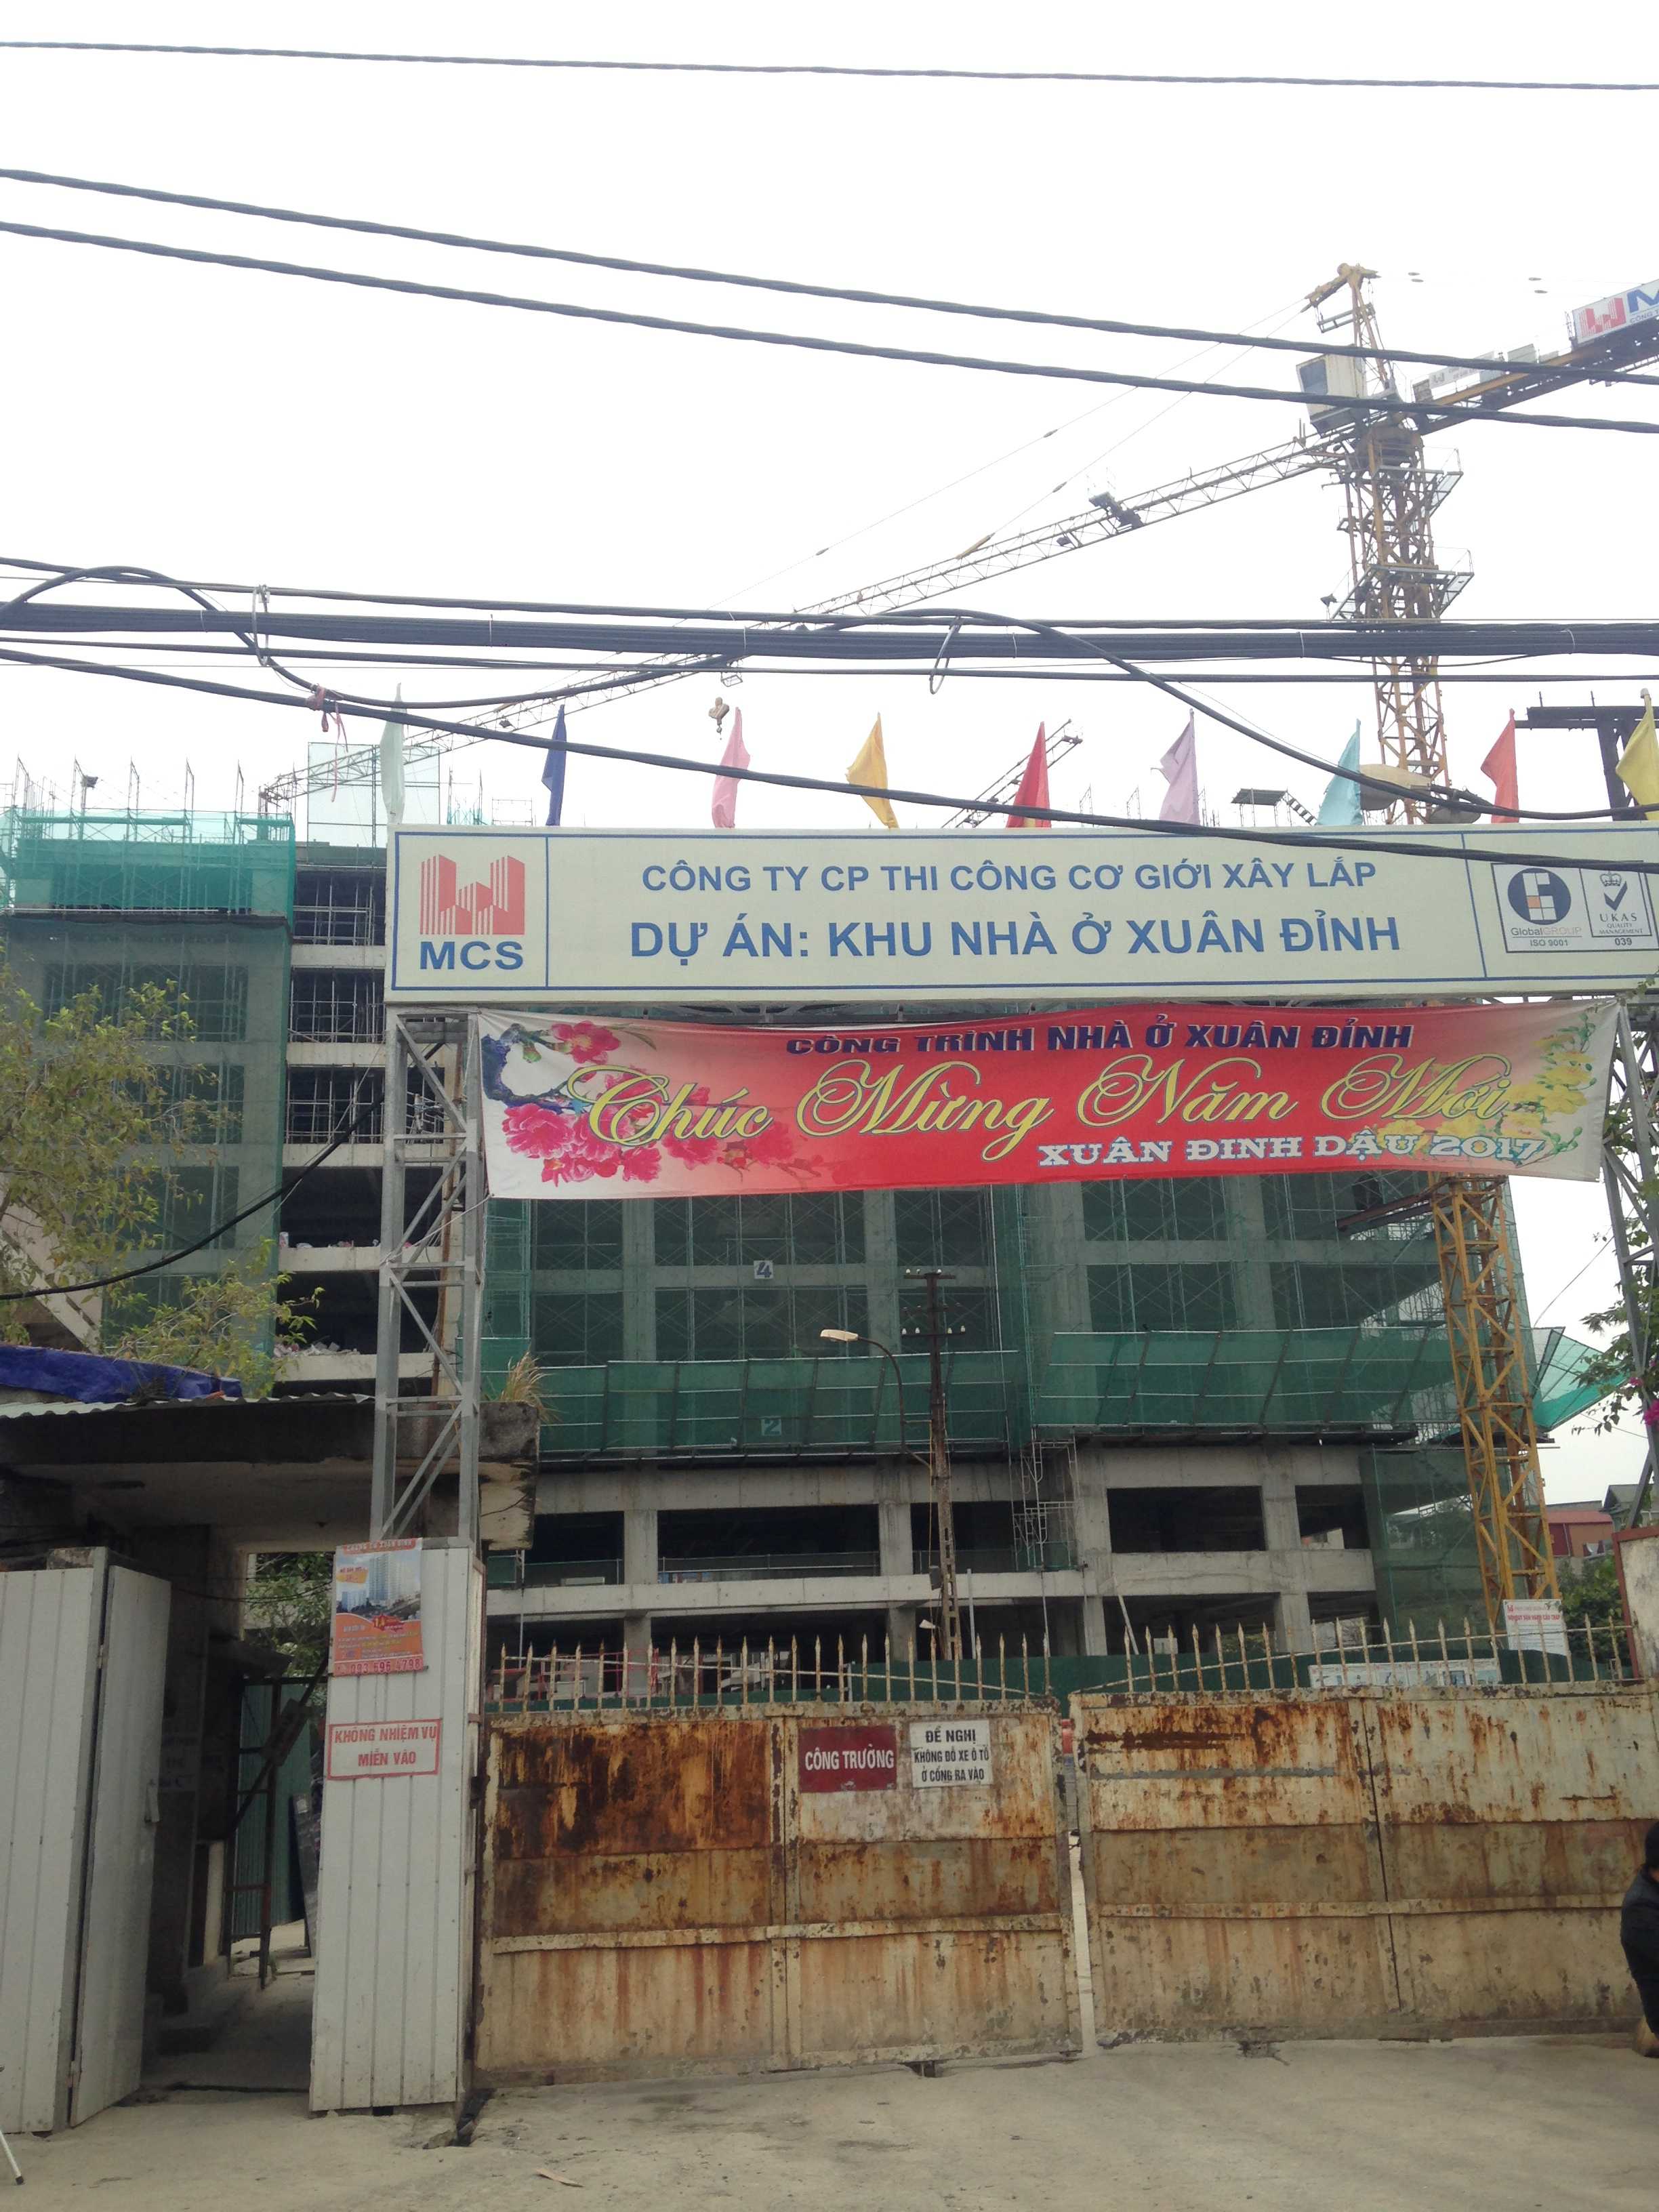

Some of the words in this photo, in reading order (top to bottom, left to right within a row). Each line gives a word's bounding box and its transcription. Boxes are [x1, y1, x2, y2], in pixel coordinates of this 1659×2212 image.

[642, 860, 751, 892] CÔNG
[763, 865, 808, 891] TY
[821, 865, 869, 892] CP
[880, 865, 938, 891] THI
[950, 859, 1056, 891] CÔNG
[1068, 864, 1123, 890] CƠ
[1135, 858, 1210, 890] GIỚI
[1223, 857, 1294, 889] XÂY
[1307, 855, 1376, 888] LẮP
[1599, 912, 1637, 922] UKAS
[632, 922, 708, 966] DỰ
[722, 913, 808, 958] ÁN:
[830, 921, 932, 957] KHU
[951, 912, 1057, 956] NHÀ
[1072, 912, 1111, 956] Ở
[1126, 909, 1265, 954] XUÂN
[1279, 909, 1399, 952] ĐỈNH
[1615, 937, 1632, 945] 039
[419, 941, 524, 970] MCS
[786, 1034, 901, 1054] CÔNG
[915, 1027, 1036, 1052] TRÌNH
[1047, 1020, 1134, 1051] NHÀ
[1145, 1013, 1177, 1049] Ở
[1187, 1020, 1300, 1049] XUÂN
[1311, 1018, 1415, 1048] ĐỈNH
[567, 1065, 774, 1147] Chúc
[796, 1059, 1054, 1162] Mừng
[1078, 1053, 1298, 1128] Năm
[1321, 1052, 1512, 1120] Mới
[1038, 1136, 1173, 1166] XUÂN
[1185, 1136, 1303, 1162] ĐINH
[1315, 1128, 1420, 1161] DẬU
[1429, 1134, 1546, 1160] 2017
[756, 1261, 772, 1277] 4
[335, 1727, 375, 1743] KHÔNG
[380, 1725, 418, 1742] NHIỆM
[422, 1726, 437, 1742] VỤ
[946, 1729, 976, 1744] NGHỊ
[358, 1748, 388, 1766] MIỄN
[805, 1746, 840, 1770] CÔNG
[842, 1743, 895, 1769] TRƯỜNG
[914, 1749, 943, 1763] KHÔNG
[958, 1750, 969, 1761] XE
[954, 1769, 966, 1781] RA
[968, 1766, 984, 1780] VÀO
